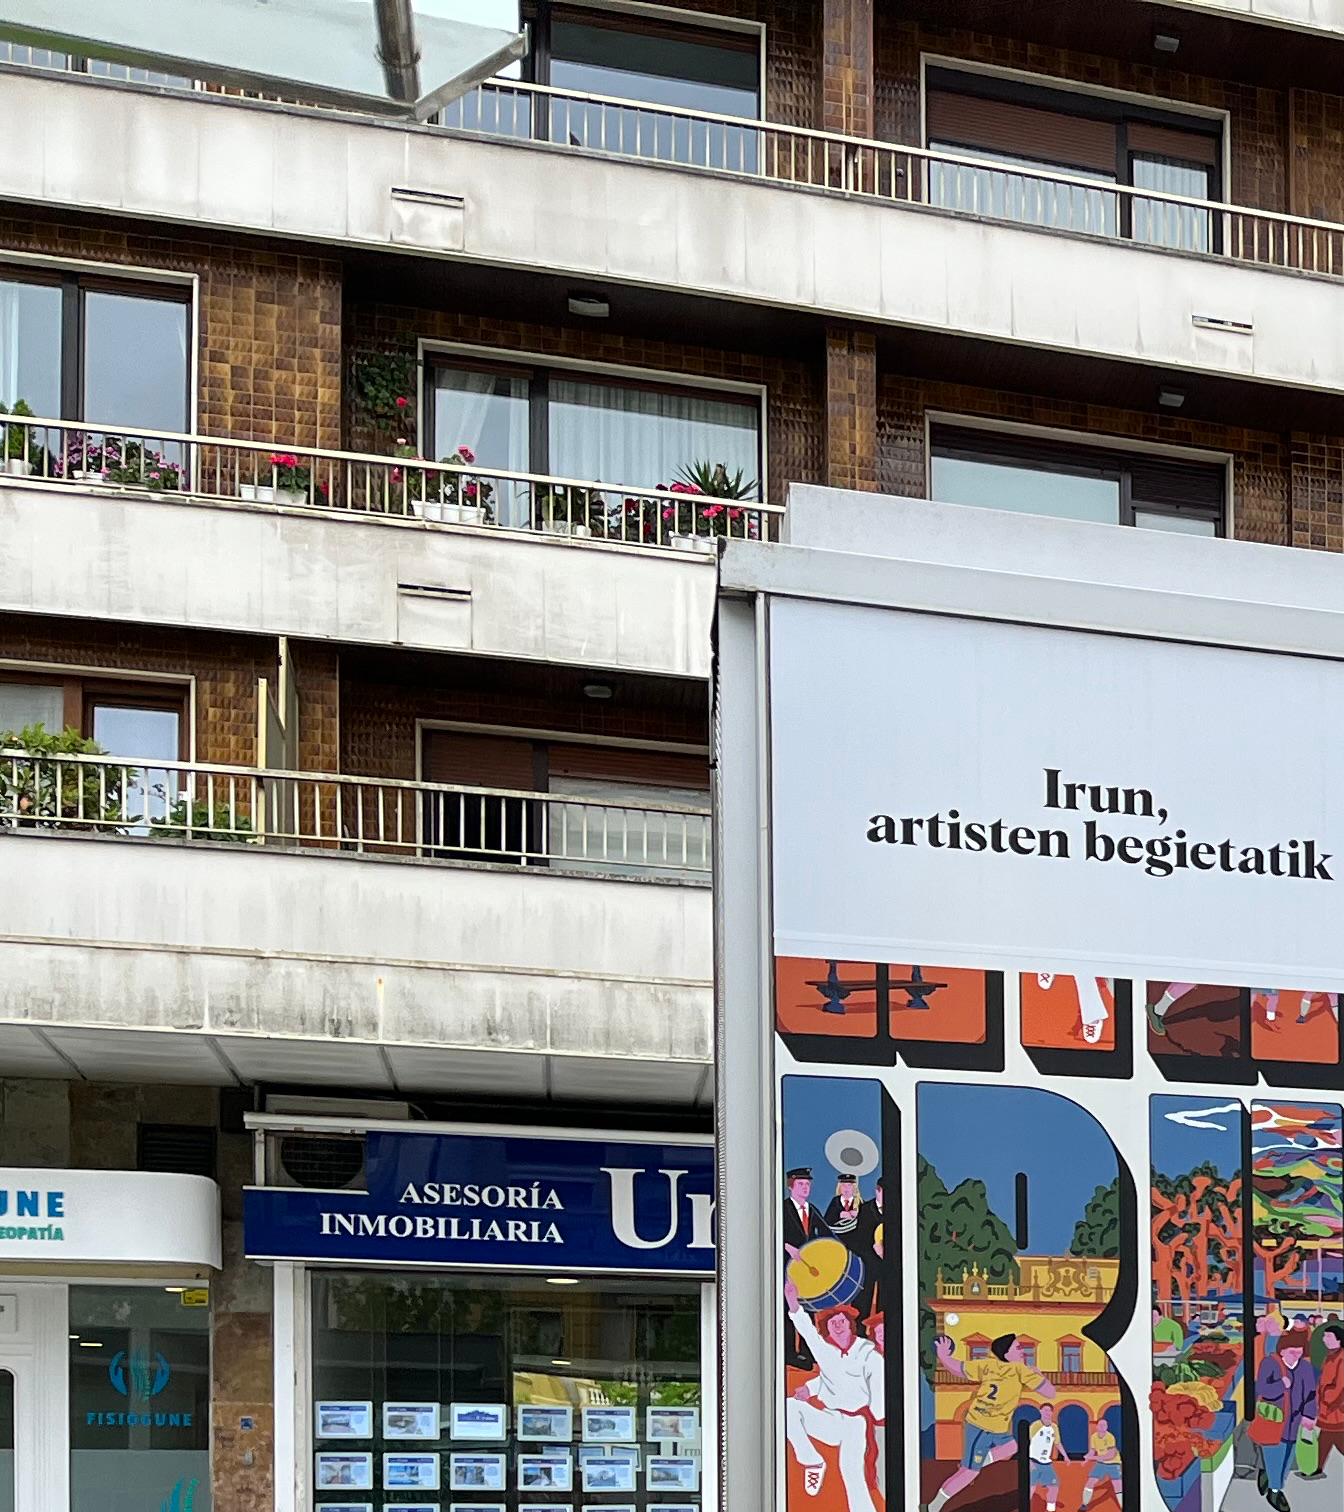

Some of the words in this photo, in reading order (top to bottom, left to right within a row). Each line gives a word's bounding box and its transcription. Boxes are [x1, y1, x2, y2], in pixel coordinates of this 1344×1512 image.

[1042, 767, 1169, 825] Irun,
[866, 809, 1071, 859] artisten
[1083, 819, 1335, 881] begietatik
[399, 1182, 564, 1210] ASESORÍA
[319, 1212, 564, 1244] INMOBILIARIA
[986, 1383, 999, 1400] 2
[86, 1411, 193, 1427] FISIOGUNE
